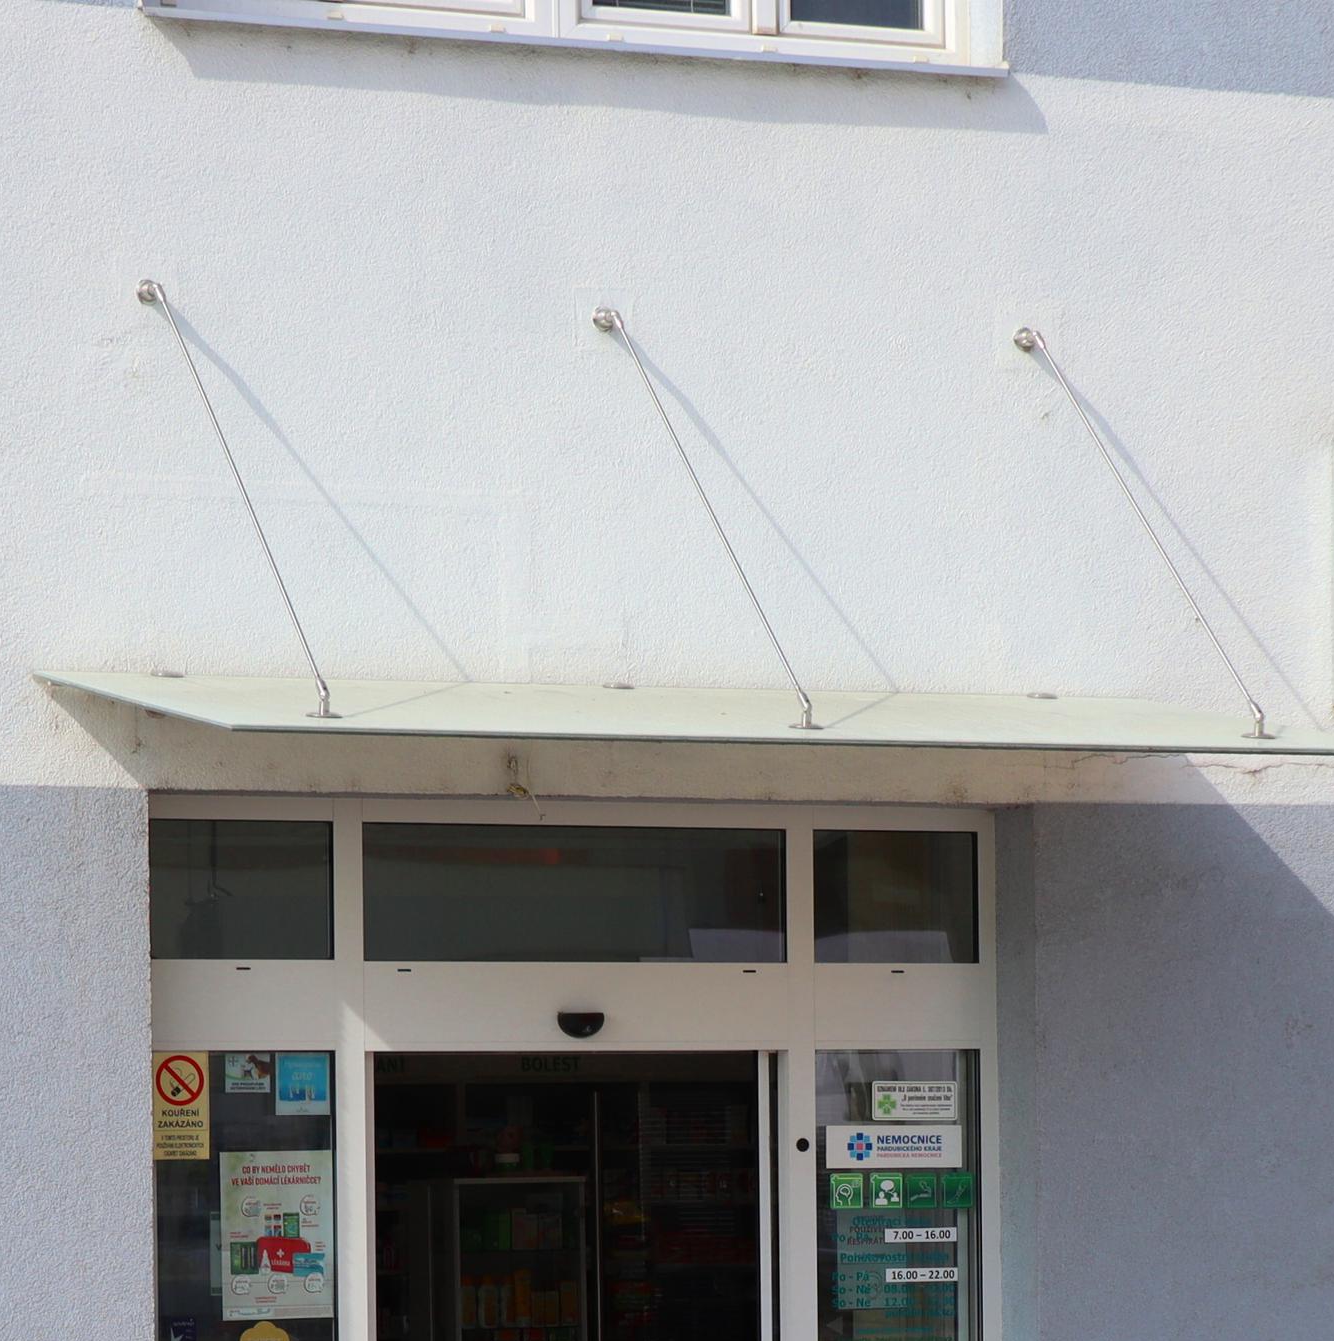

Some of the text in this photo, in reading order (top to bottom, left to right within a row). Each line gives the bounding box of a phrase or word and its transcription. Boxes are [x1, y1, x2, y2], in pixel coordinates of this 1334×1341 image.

[521, 1056, 581, 1072] BOLEST
[161, 1108, 200, 1118] KOUŘENÍ
[158, 1118, 204, 1128] ZAKÁZÁNO
[877, 1135, 942, 1144] NEMOCNICE
[877, 1144, 922, 1152] PARDUBICKÉHO
[242, 1163, 310, 1174] CO BY NEMĚLO CHYBĚT
[231, 1178, 239, 1186] VE
[893, 1231, 914, 1240] 7.00
[925, 1230, 951, 1239] 16.00
[892, 1271, 918, 1280] 16.00
[928, 1270, 955, 1279] 22.00
